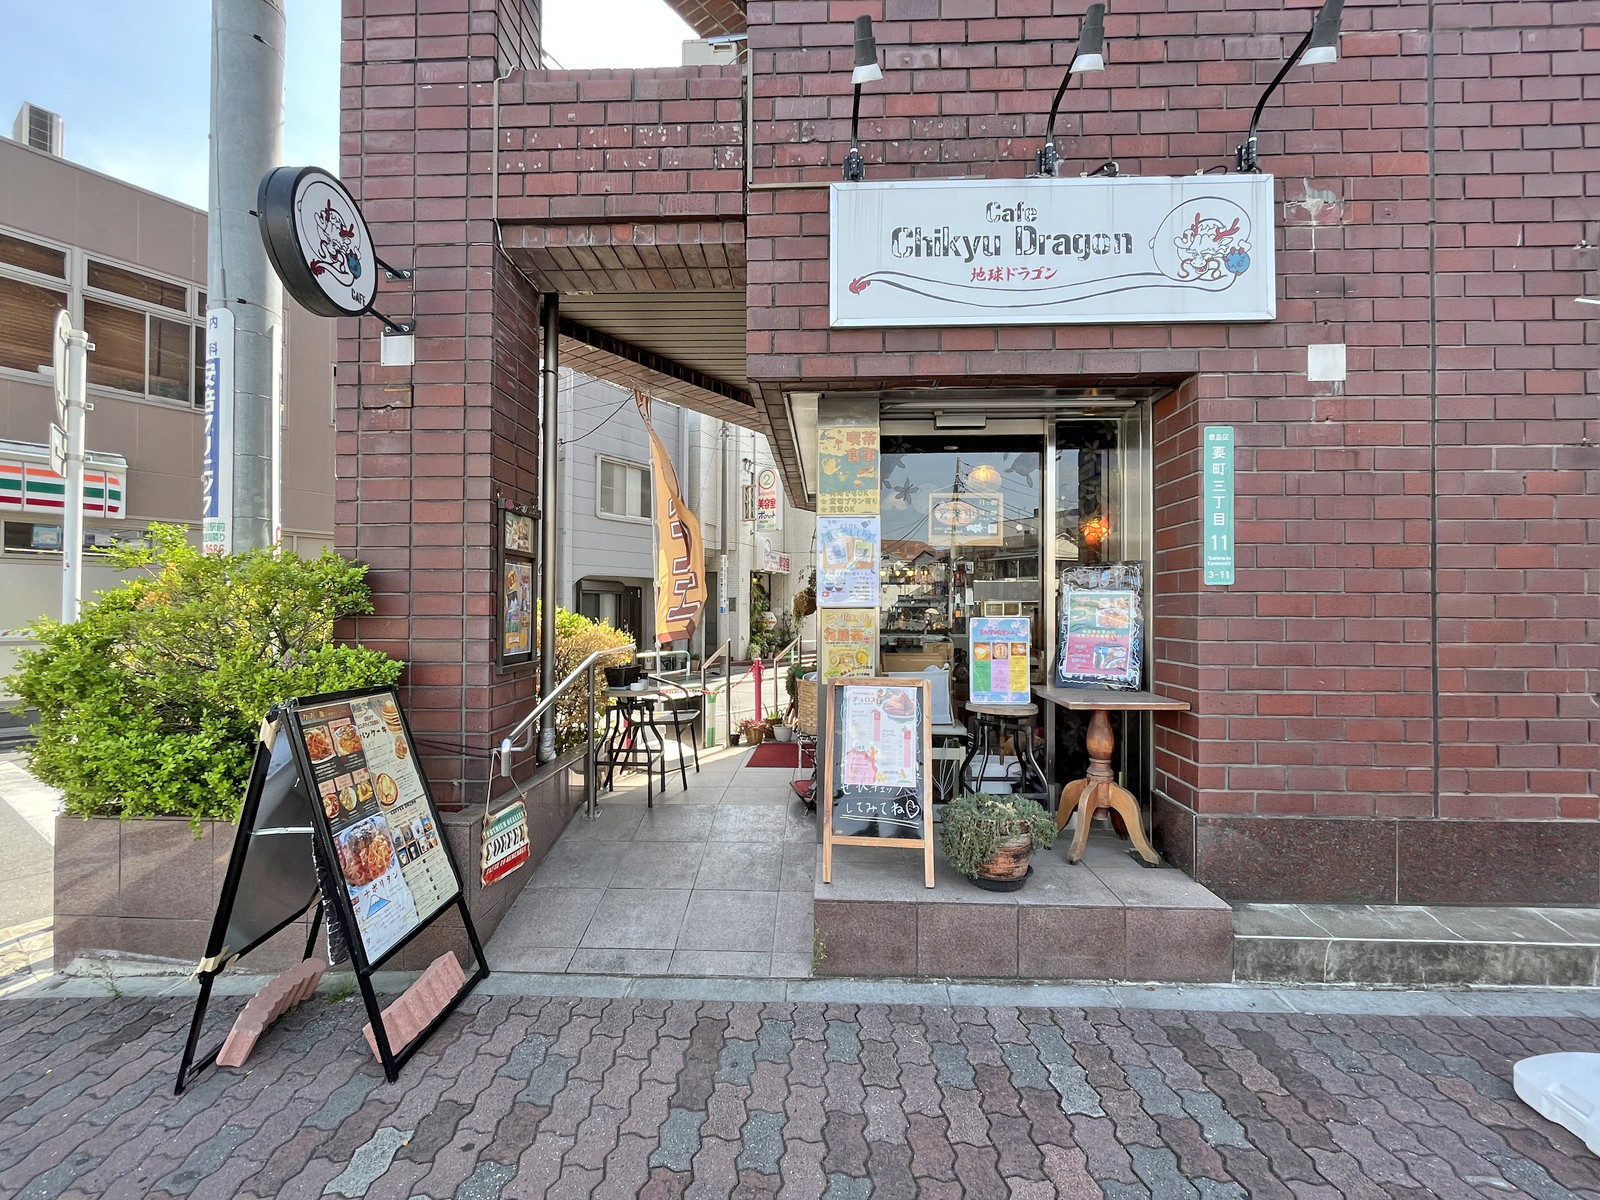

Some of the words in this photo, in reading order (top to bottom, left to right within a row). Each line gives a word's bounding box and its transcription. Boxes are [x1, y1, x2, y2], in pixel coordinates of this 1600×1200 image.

[985, 201, 1039, 223] Cafe
[891, 226, 1001, 262] Chikyu
[1014, 225, 1133, 261] Dragon
[970, 266, 1060, 283] 地球ドラゴン
[351, 288, 367, 306] CAFE
[1208, 433, 1229, 441] 豊島区
[847, 447, 876, 462] 食事
[763, 473, 771, 485] 2
[1212, 445, 1226, 526] 要町三丁目
[758, 498, 776, 510] 美容室
[1211, 534, 1228, 551] 11
[1208, 571, 1230, 579] 3-11
[846, 801, 905, 816] してみてね
[486, 823, 526, 862] COFFEE
[364, 872, 398, 898] ナポリタン
